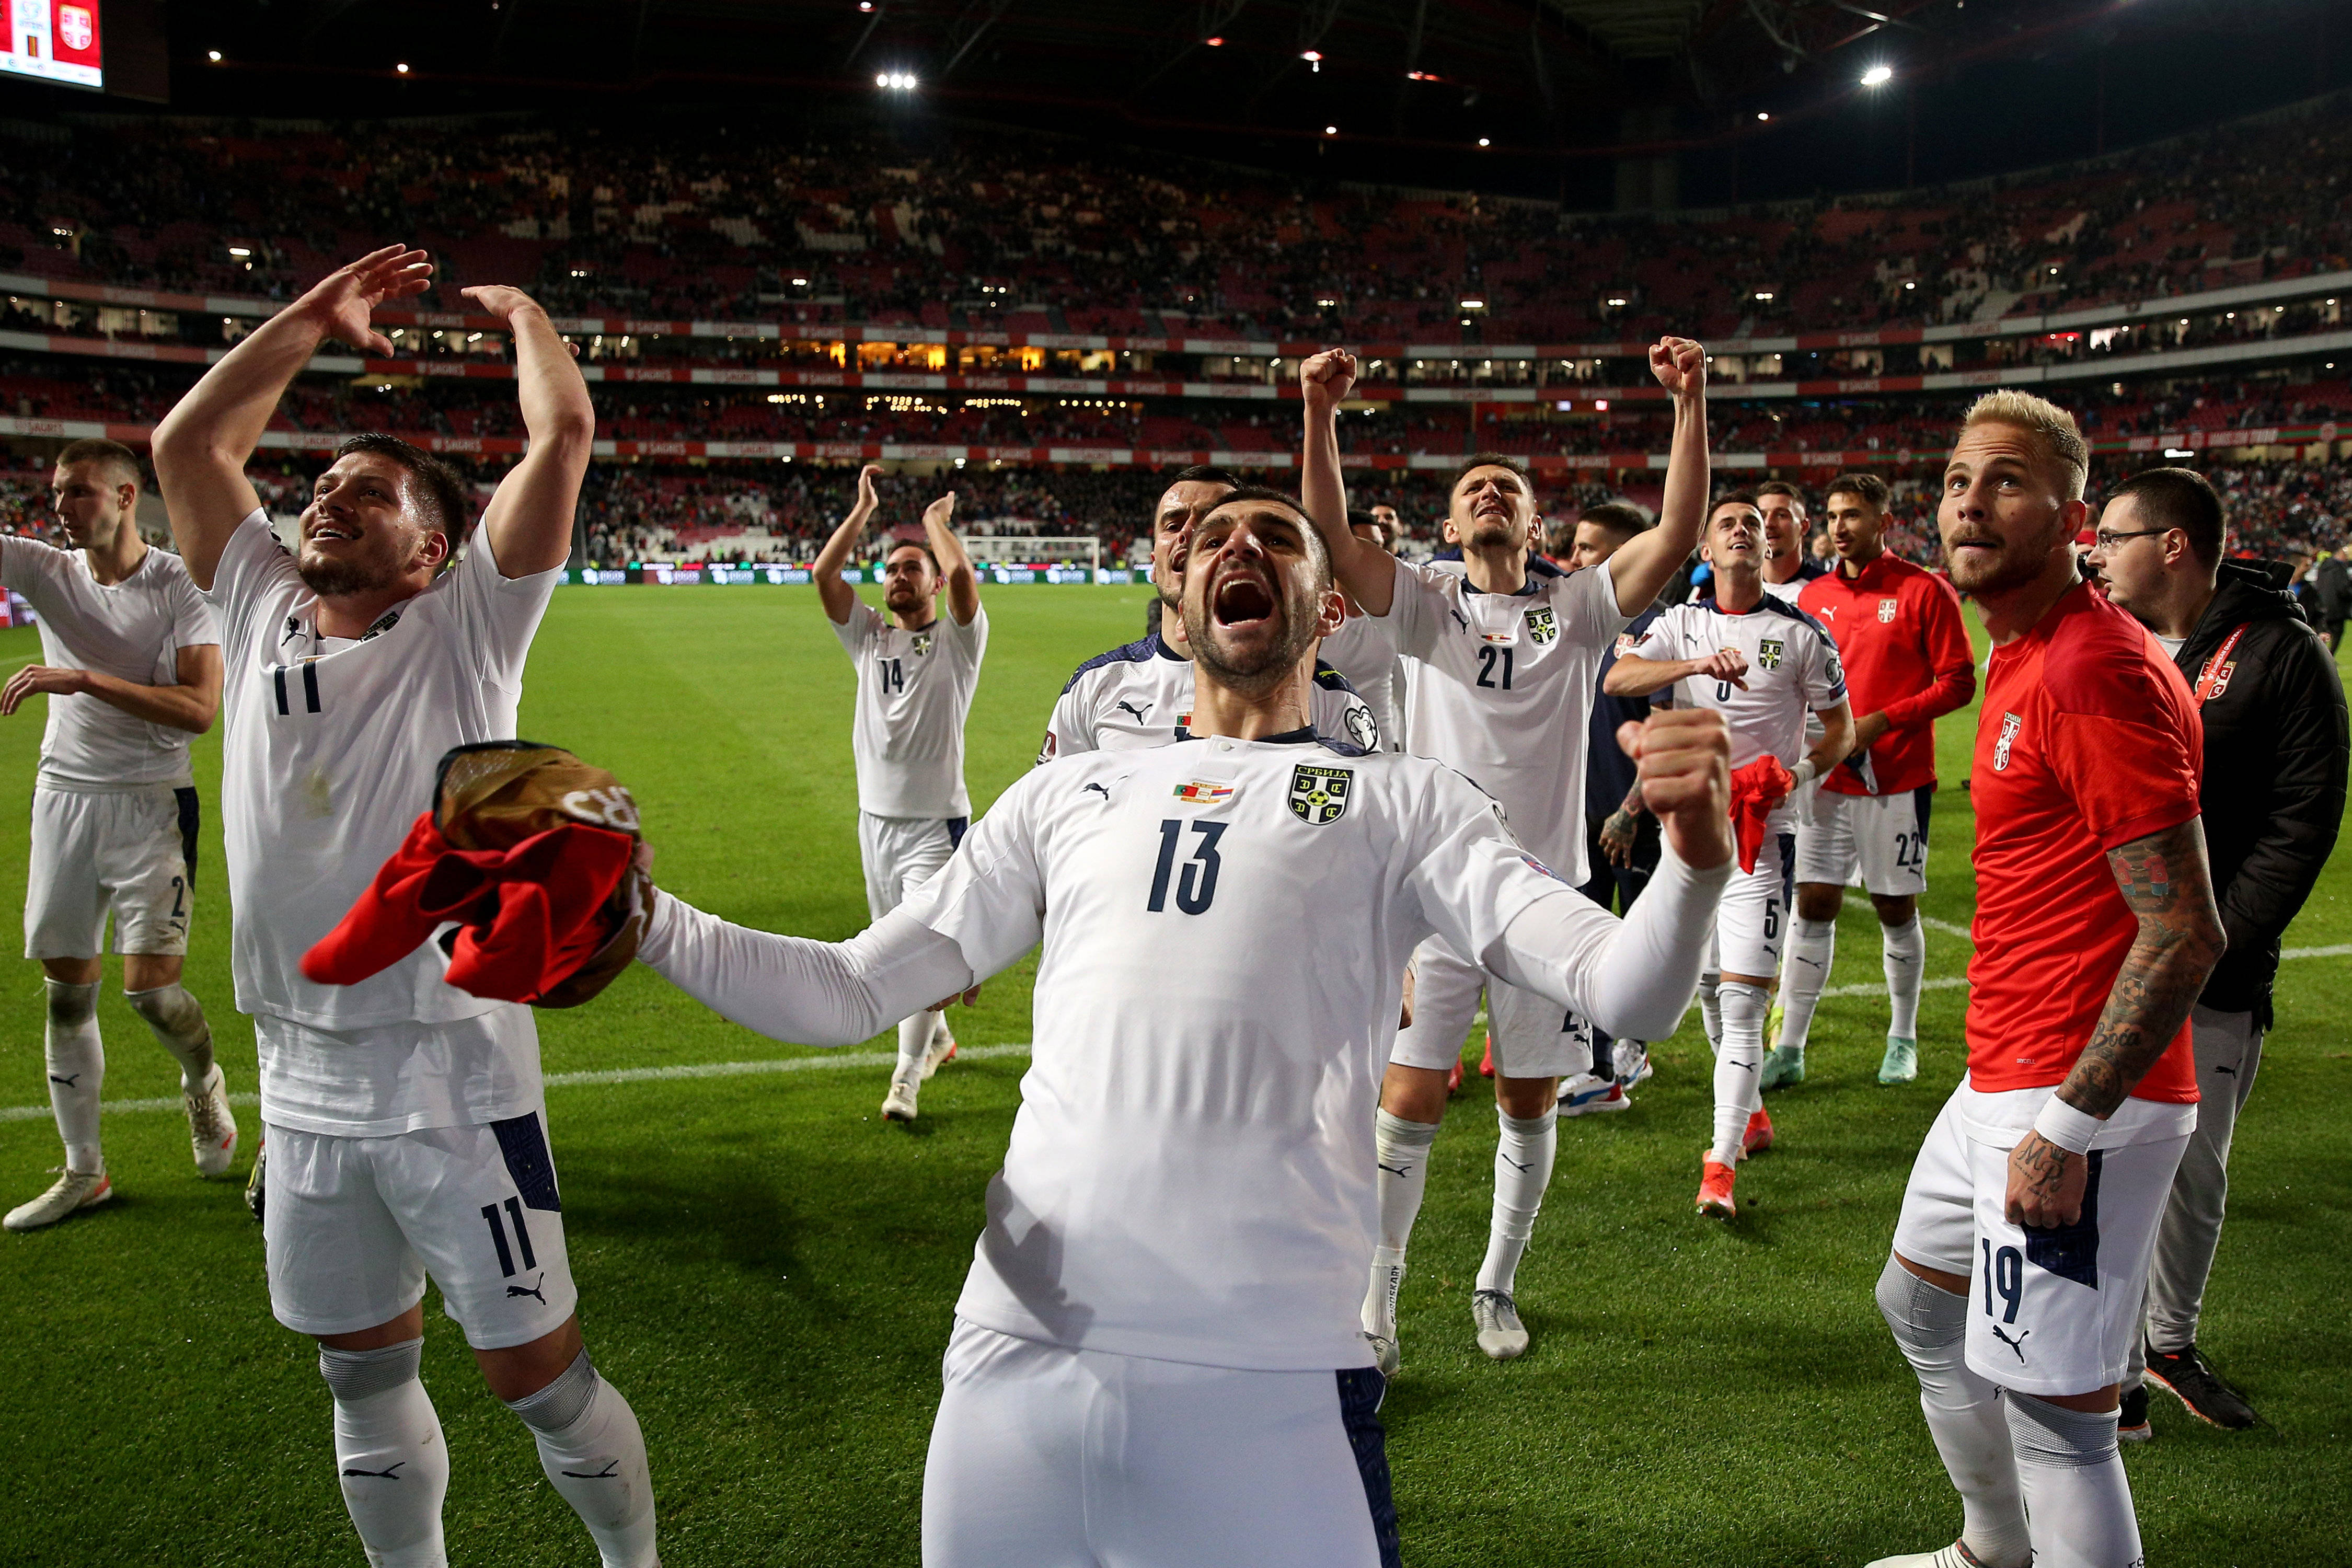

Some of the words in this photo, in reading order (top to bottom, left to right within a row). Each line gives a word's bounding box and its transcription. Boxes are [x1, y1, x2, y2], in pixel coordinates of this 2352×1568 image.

[275, 661, 321, 715] 11
[881, 659, 904, 694] 14
[1477, 645, 1513, 690] 21
[1297, 766, 1350, 778] СРБИЈА
[1147, 819, 1229, 916] 13
[1896, 832, 1922, 866] 22
[171, 875, 185, 917] 2
[1764, 898, 1780, 939] 5
[481, 1195, 537, 1278] 11
[1982, 1237, 2023, 1324] 19
